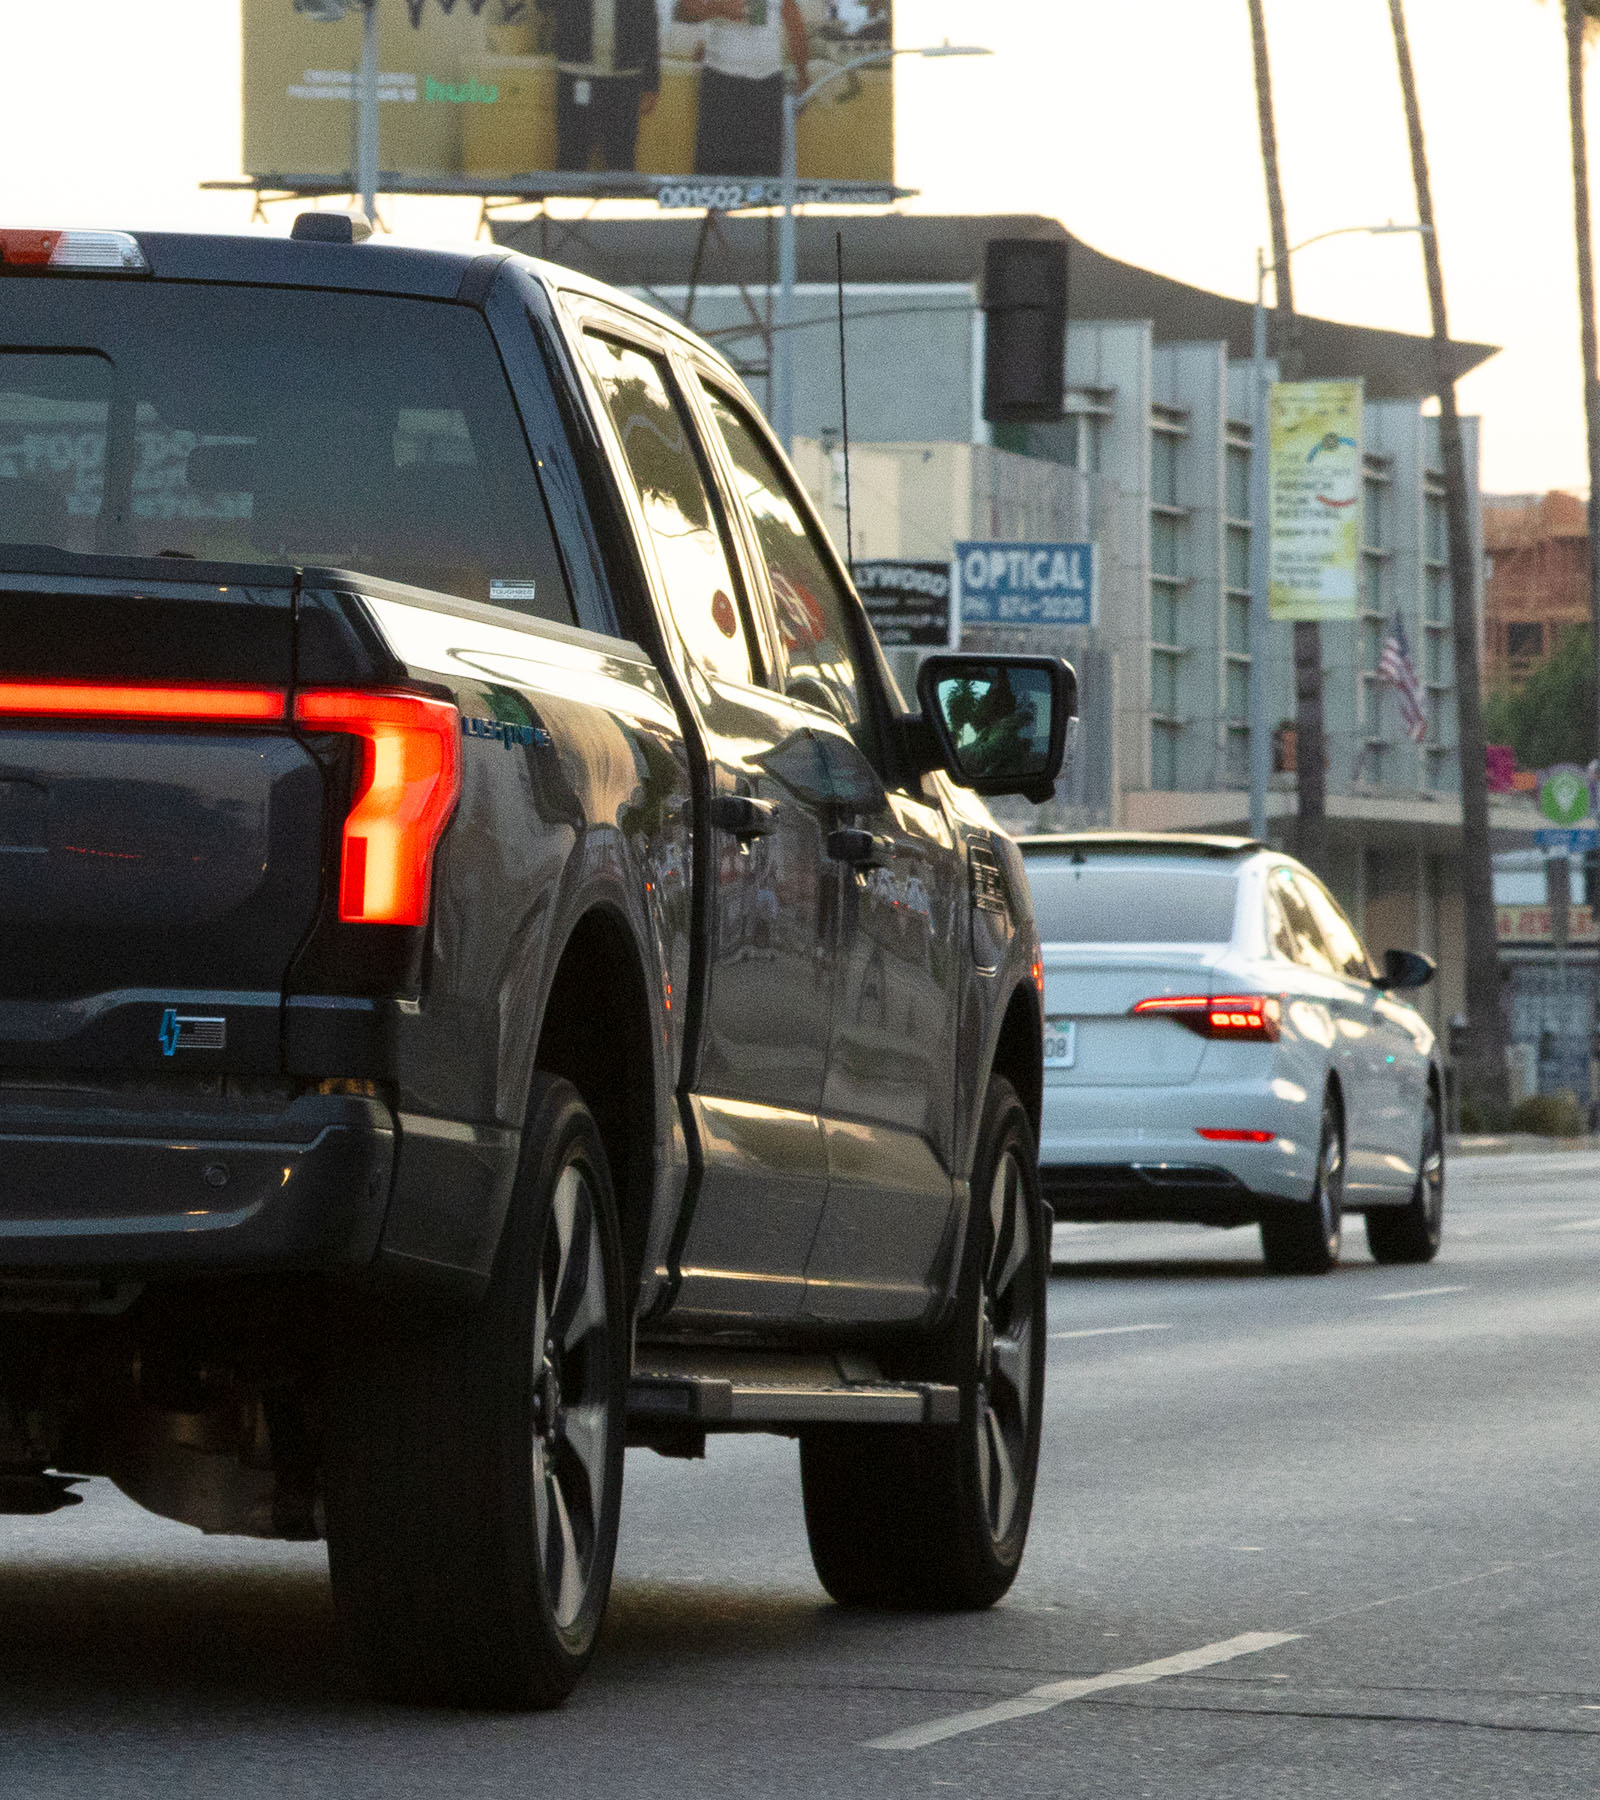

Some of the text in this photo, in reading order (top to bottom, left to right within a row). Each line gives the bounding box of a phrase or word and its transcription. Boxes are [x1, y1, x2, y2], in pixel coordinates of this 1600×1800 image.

[425, 75, 498, 103] hulu
[658, 186, 742, 210] 001502
[854, 566, 949, 597] LYWOOD
[964, 550, 1085, 591] OPTICAL
